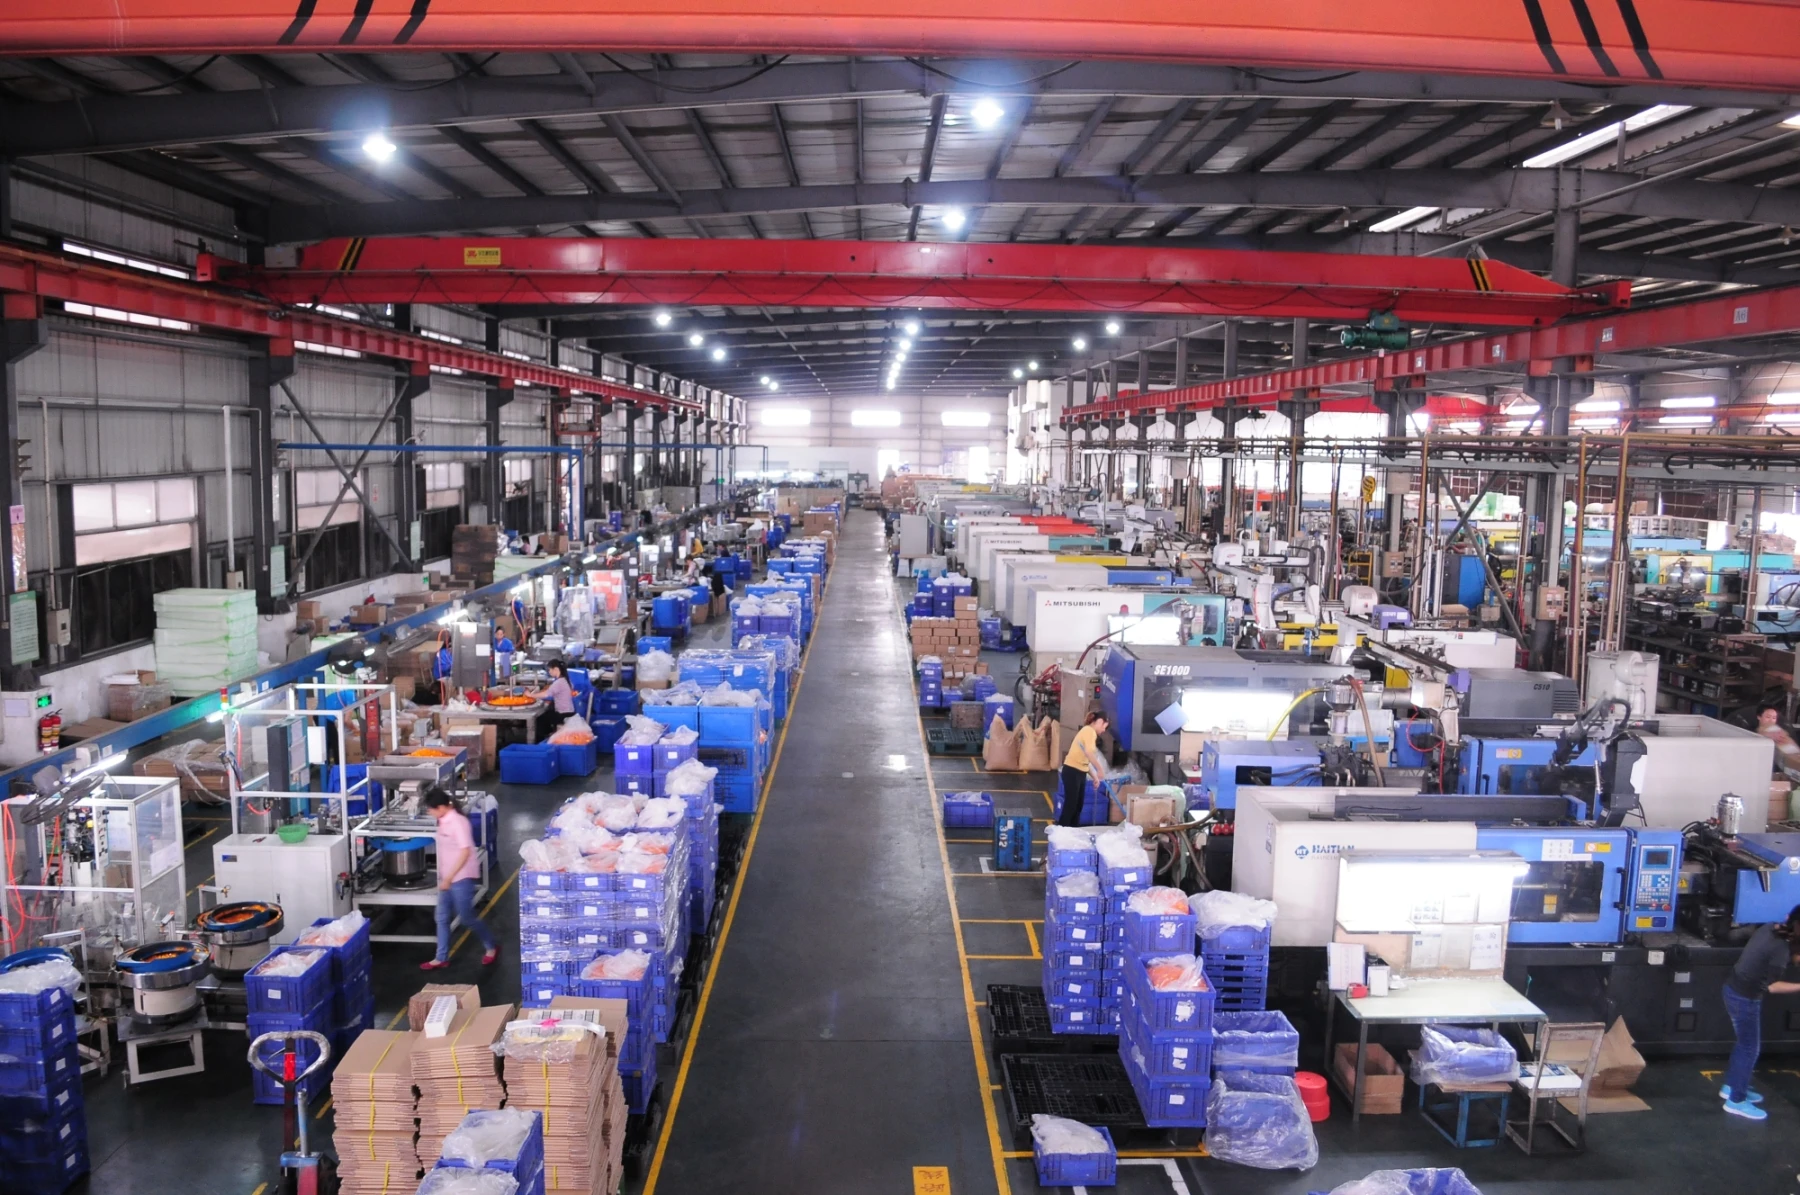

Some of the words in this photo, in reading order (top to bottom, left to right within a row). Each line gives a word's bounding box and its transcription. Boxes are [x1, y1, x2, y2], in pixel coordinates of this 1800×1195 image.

[1153, 664, 1190, 676] SE180D
[1533, 683, 1551, 691] C510
[998, 825, 1008, 848] 302
